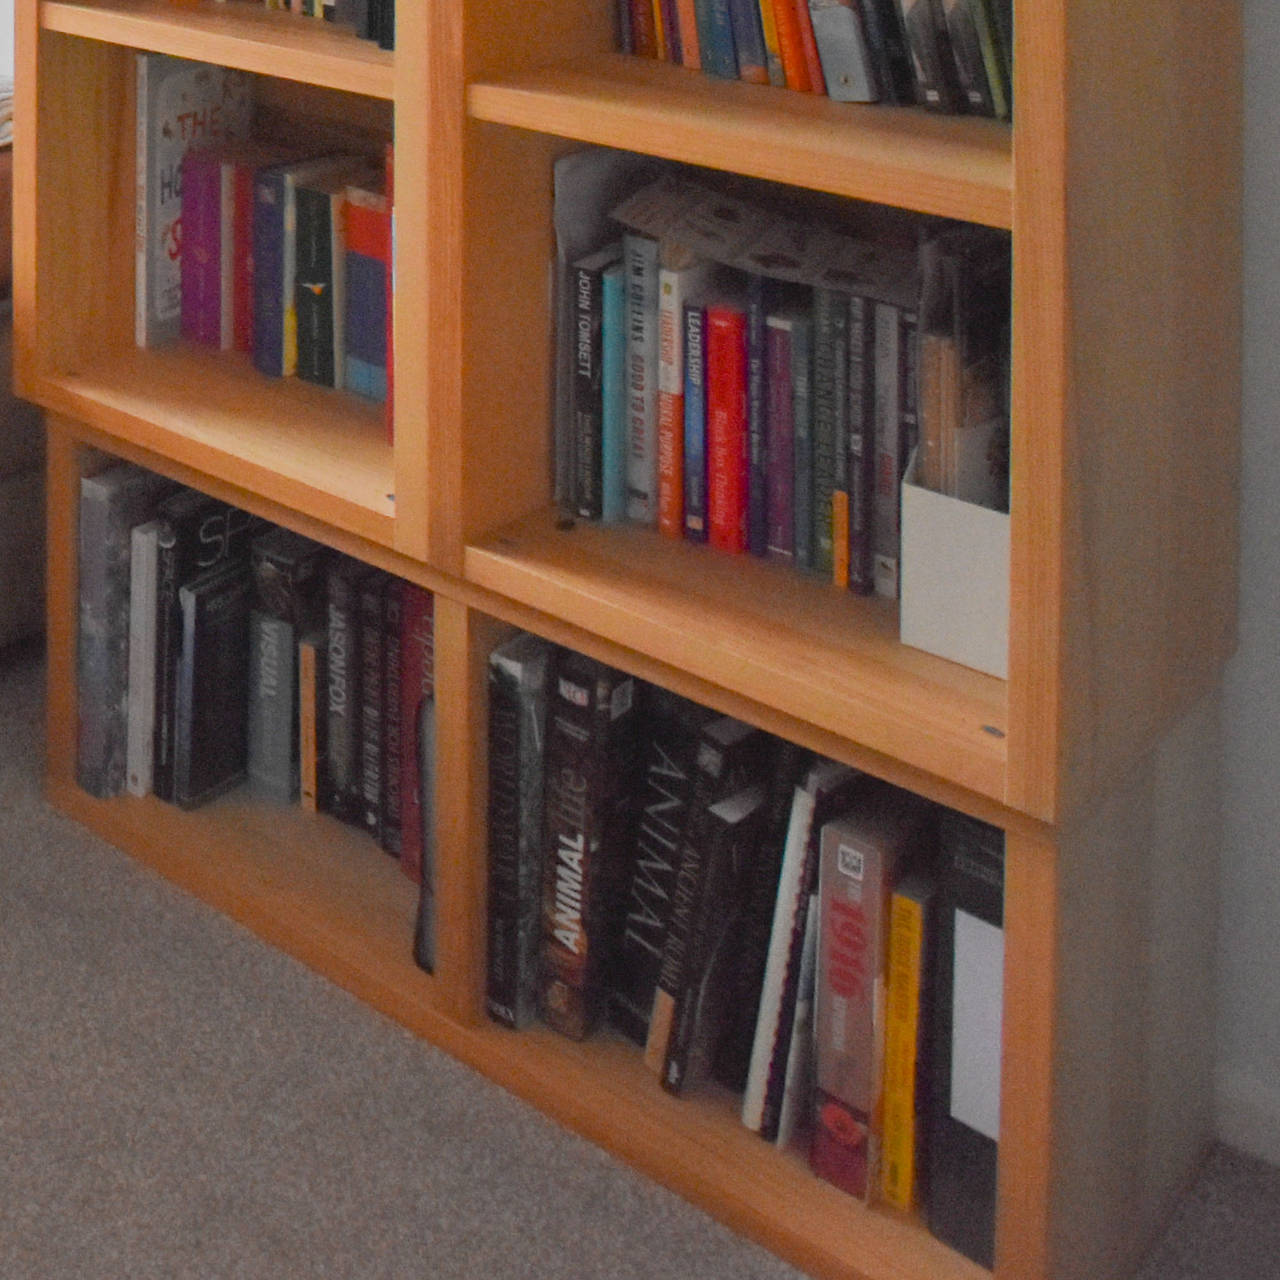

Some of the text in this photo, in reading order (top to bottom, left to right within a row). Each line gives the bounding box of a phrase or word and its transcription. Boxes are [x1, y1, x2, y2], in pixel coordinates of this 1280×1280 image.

[578, 269, 591, 379] JOHN TOMSETT
[631, 283, 645, 342] COLLINS
[687, 311, 701, 385] LEADERSHIP
[713, 471, 728, 526] Thinking
[259, 622, 279, 698] VISUAL
[329, 604, 346, 672] JASON
[329, 673, 346, 718] FOX
[625, 740, 689, 956] ANIMAL
[554, 833, 584, 955] ANIMAL
